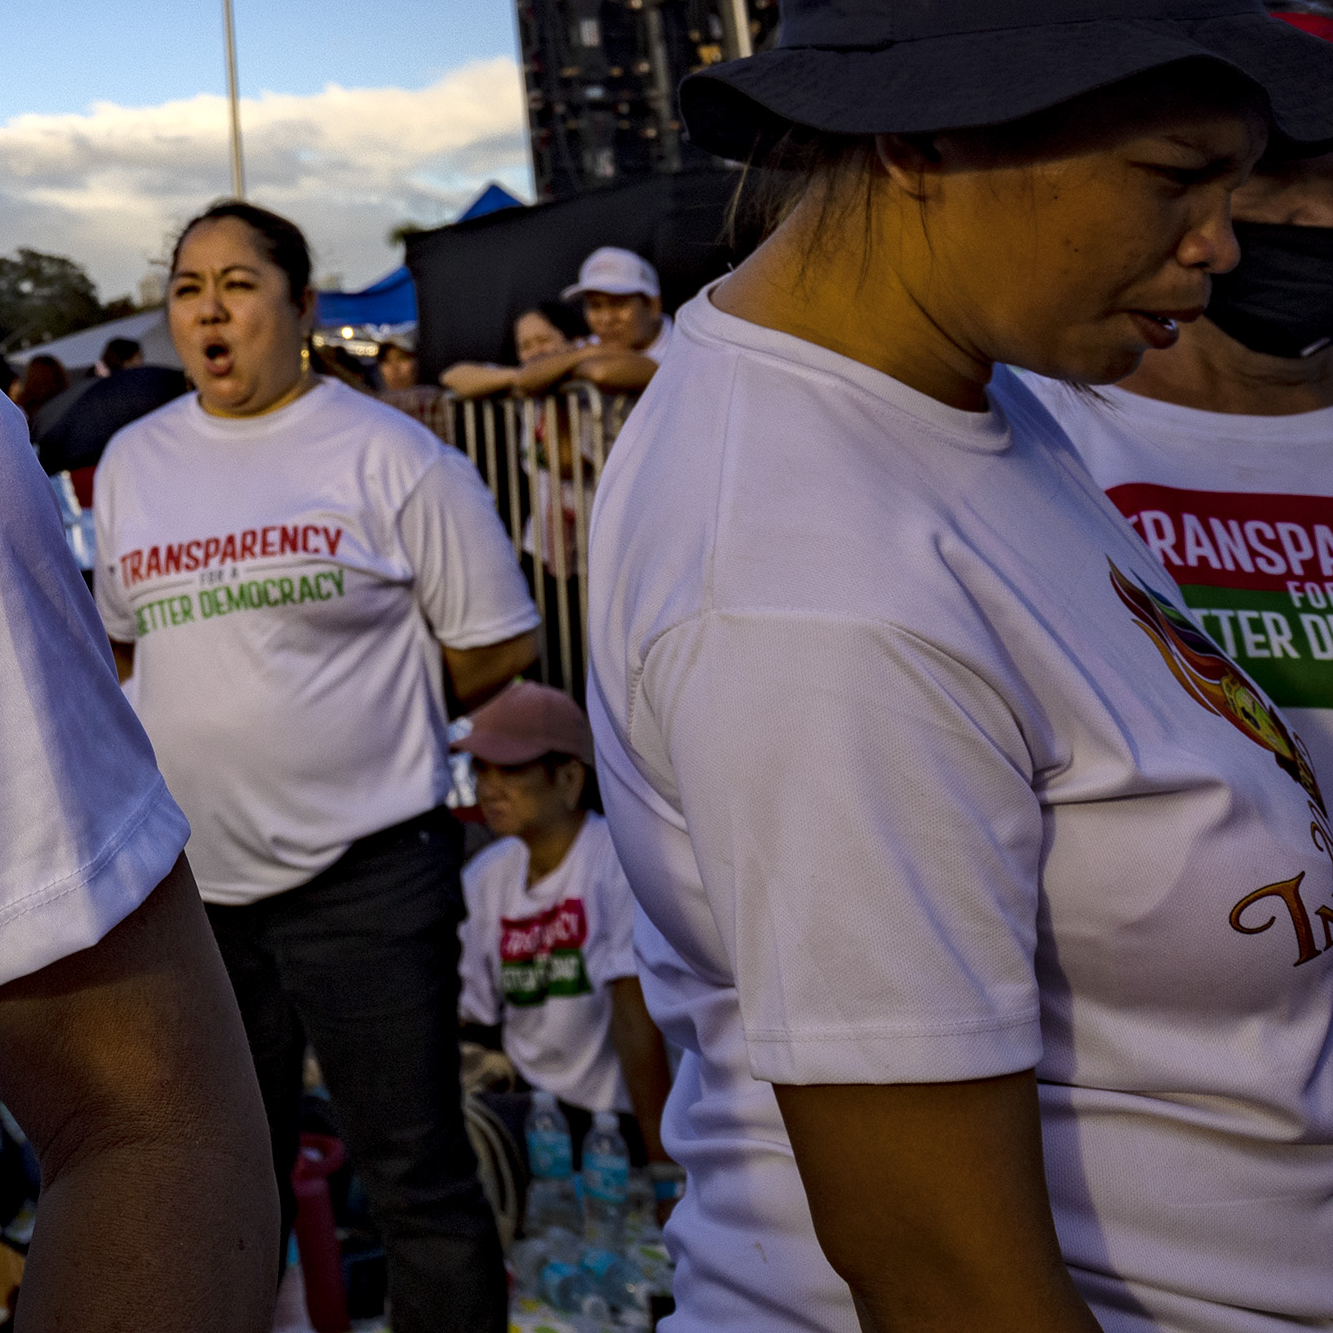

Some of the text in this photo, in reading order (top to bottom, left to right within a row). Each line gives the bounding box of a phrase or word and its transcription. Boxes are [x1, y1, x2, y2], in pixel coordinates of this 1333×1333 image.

[120, 524, 343, 589] TRANSPARENCY
[1128, 509, 1333, 577] RANSPA
[198, 568, 344, 620] DEMOCRACY
